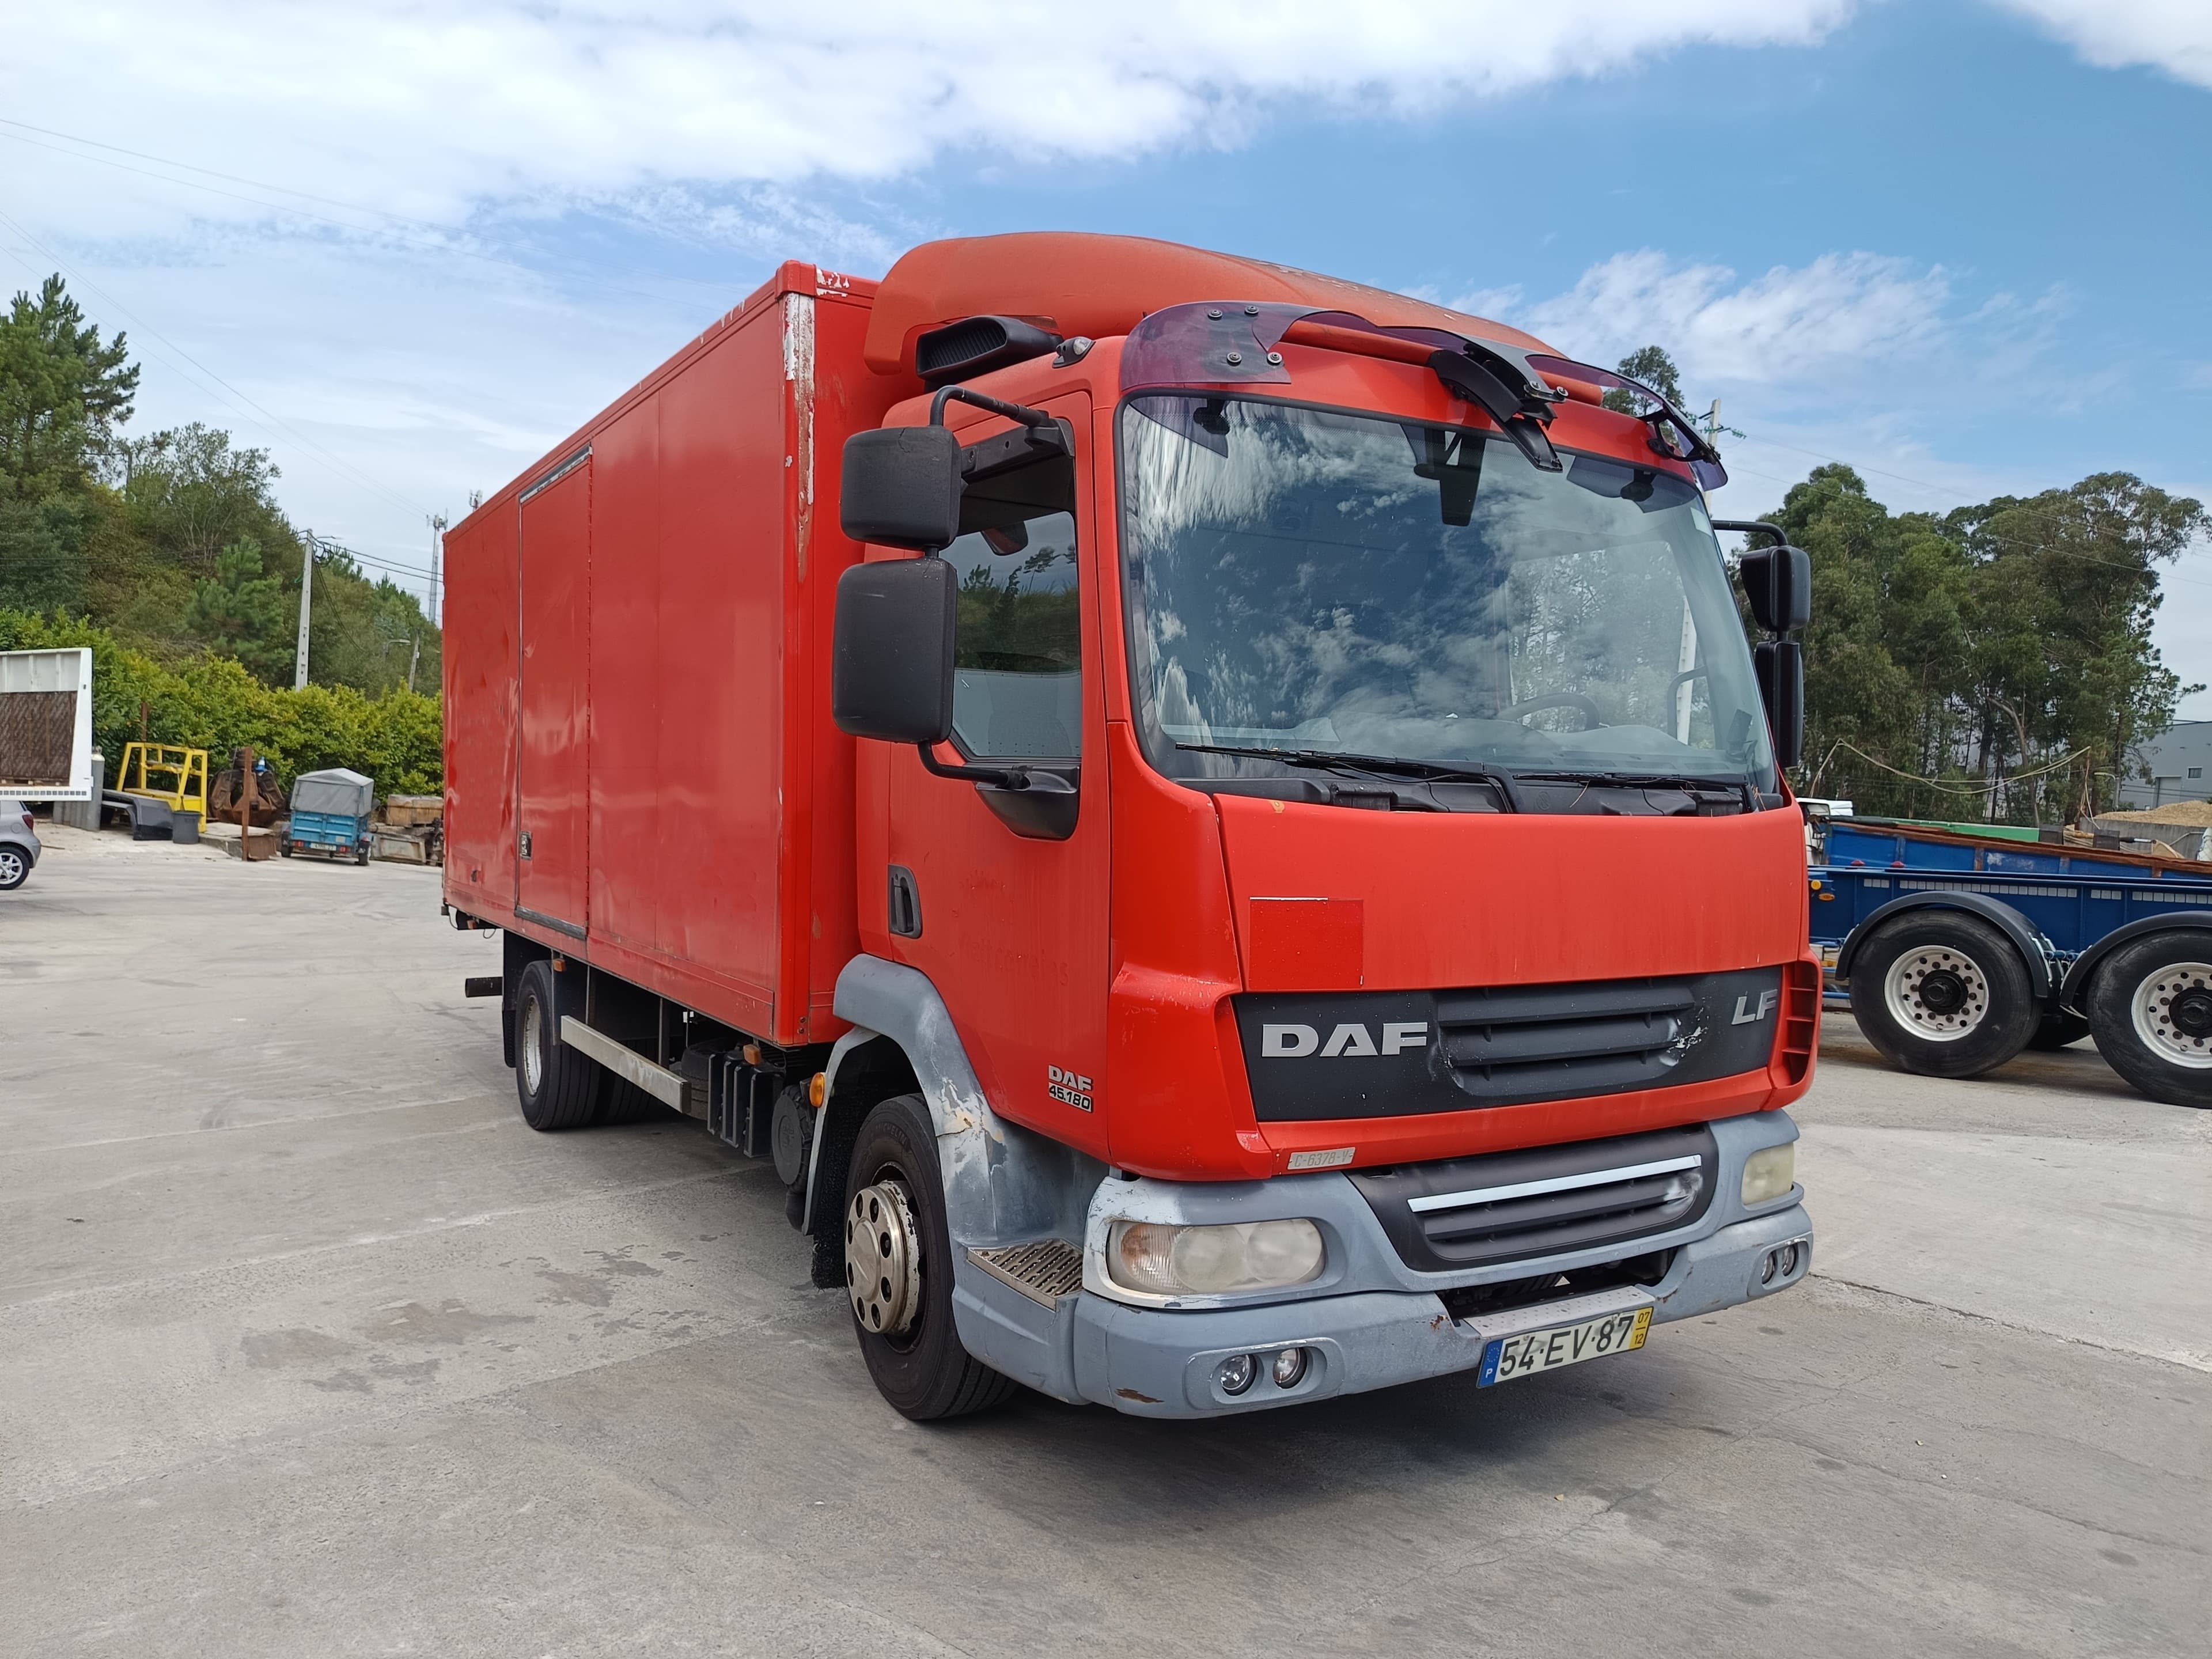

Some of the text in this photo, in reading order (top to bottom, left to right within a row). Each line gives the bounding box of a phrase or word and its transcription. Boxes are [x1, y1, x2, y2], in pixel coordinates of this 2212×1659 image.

[1731, 989, 1778, 1025] LF
[1262, 1022, 1428, 1057] DAF
[1048, 1065, 1092, 1091] DAF
[1049, 1085, 1090, 1109] 45.180
[1294, 1150, 1349, 1167] C-6378-V
[1638, 1311, 1650, 1324] 07
[1634, 1333, 1644, 1344] 12
[1485, 1368, 1493, 1378] P
